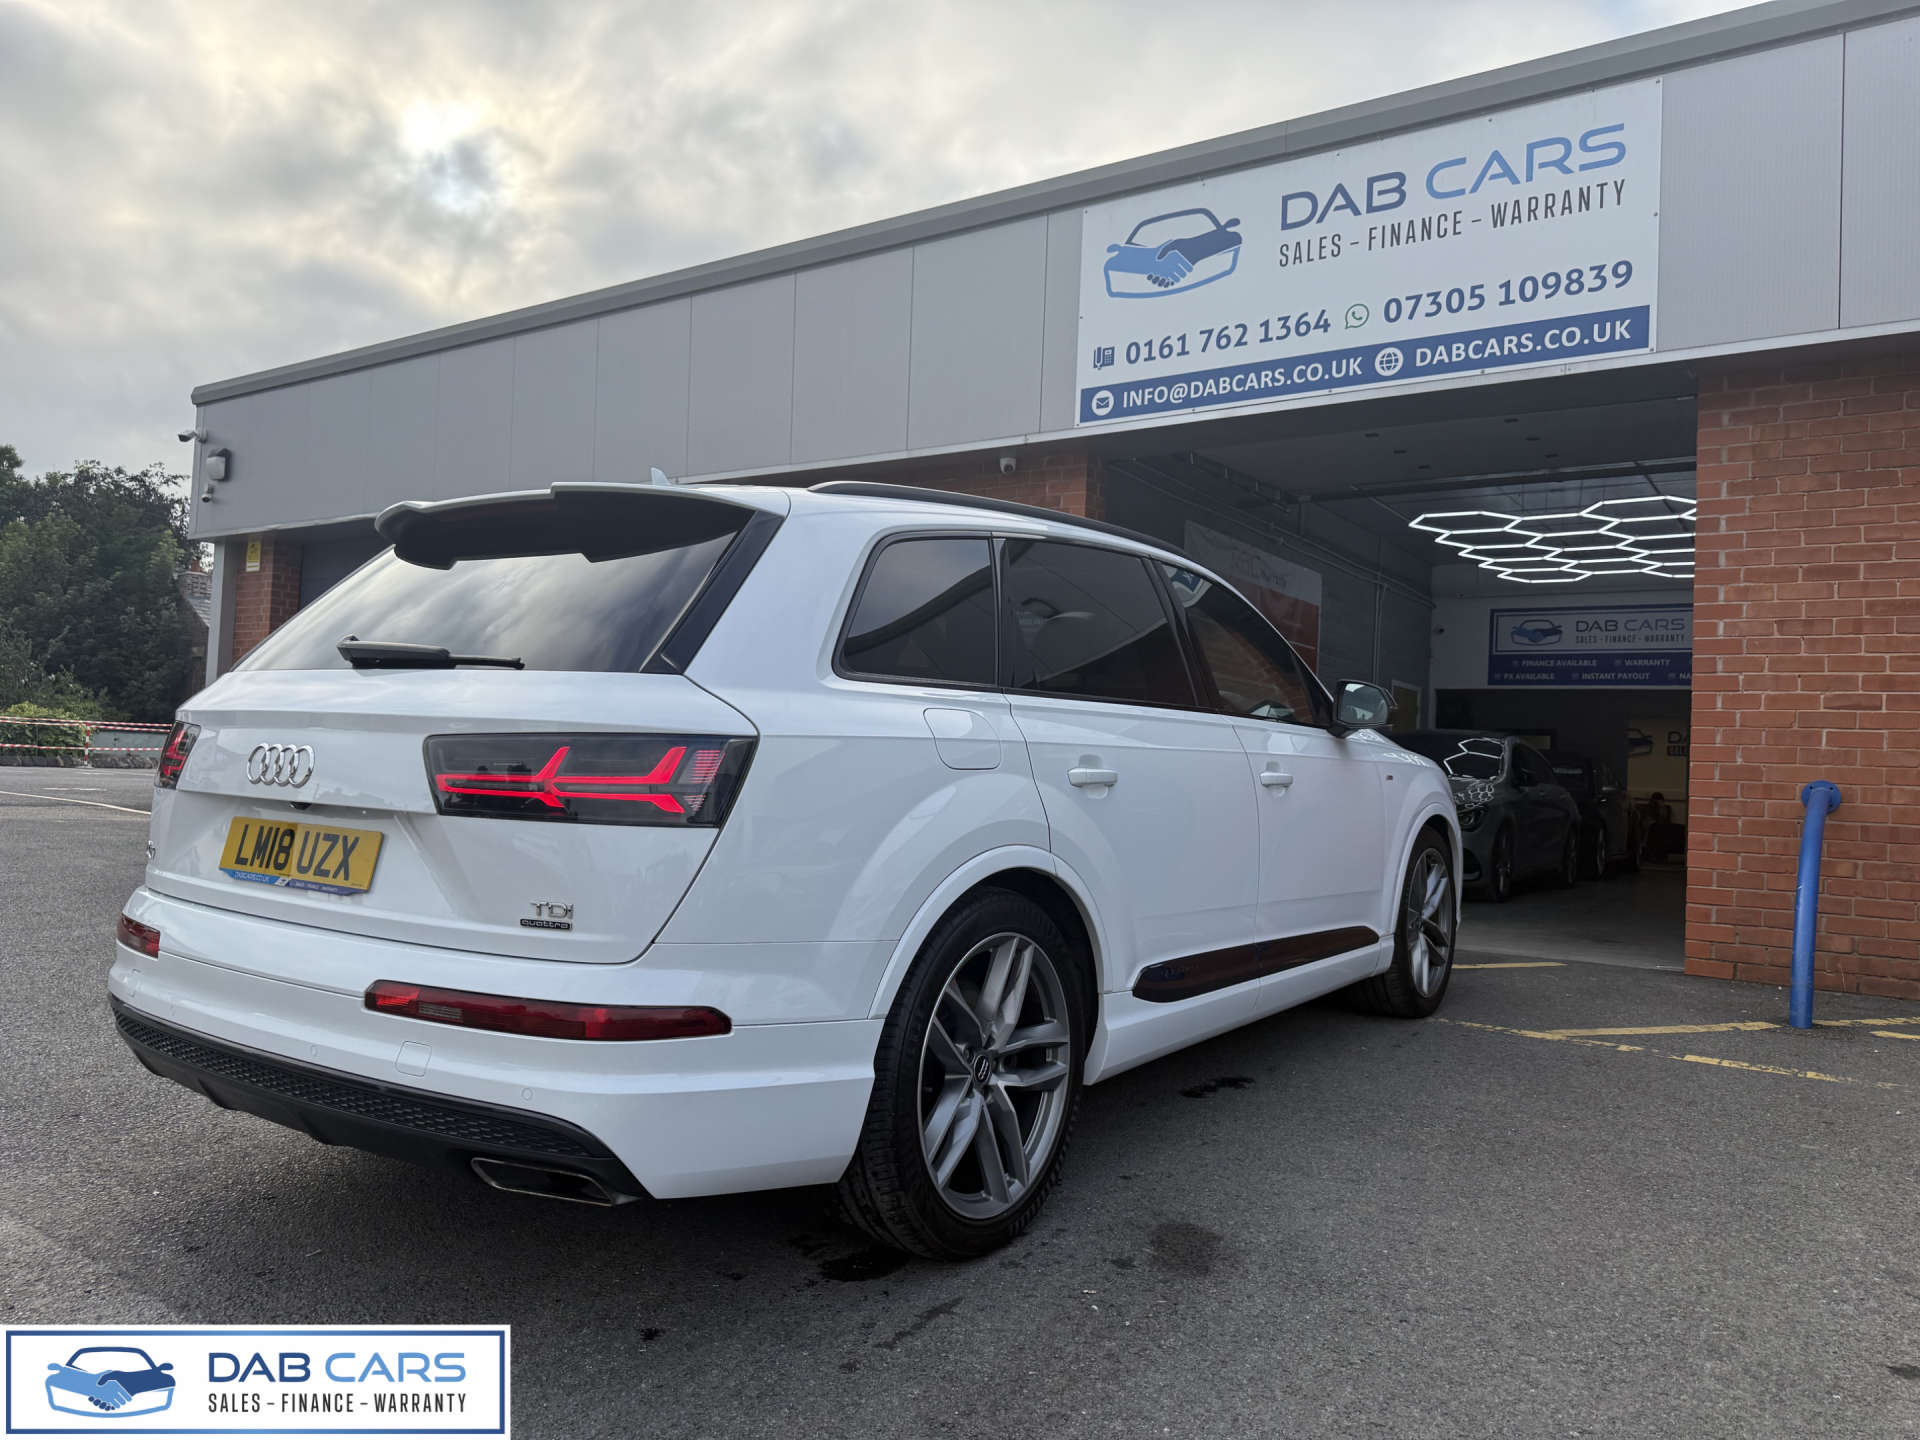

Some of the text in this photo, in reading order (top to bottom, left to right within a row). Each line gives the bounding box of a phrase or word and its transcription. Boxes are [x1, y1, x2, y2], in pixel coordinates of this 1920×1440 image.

[1280, 122, 1627, 232] DAB CARS
[1279, 233, 1342, 268] SALES
[1368, 211, 1463, 252] FINANCE
[1490, 179, 1627, 229] WARRANTY
[1382, 259, 1634, 325] 07305 109839
[1125, 308, 1331, 365] 0161 762 1364
[1415, 319, 1632, 368] DABCARS.CO.UK
[1122, 356, 1364, 409] INFO@DABCARS.CO.UK
[1576, 618, 1685, 632] DAB CARS
[1582, 672, 1650, 680] INSTANT PAYOUT
[1624, 658, 1671, 667] WARRANTY
[234, 824, 360, 881] LM18 UZX
